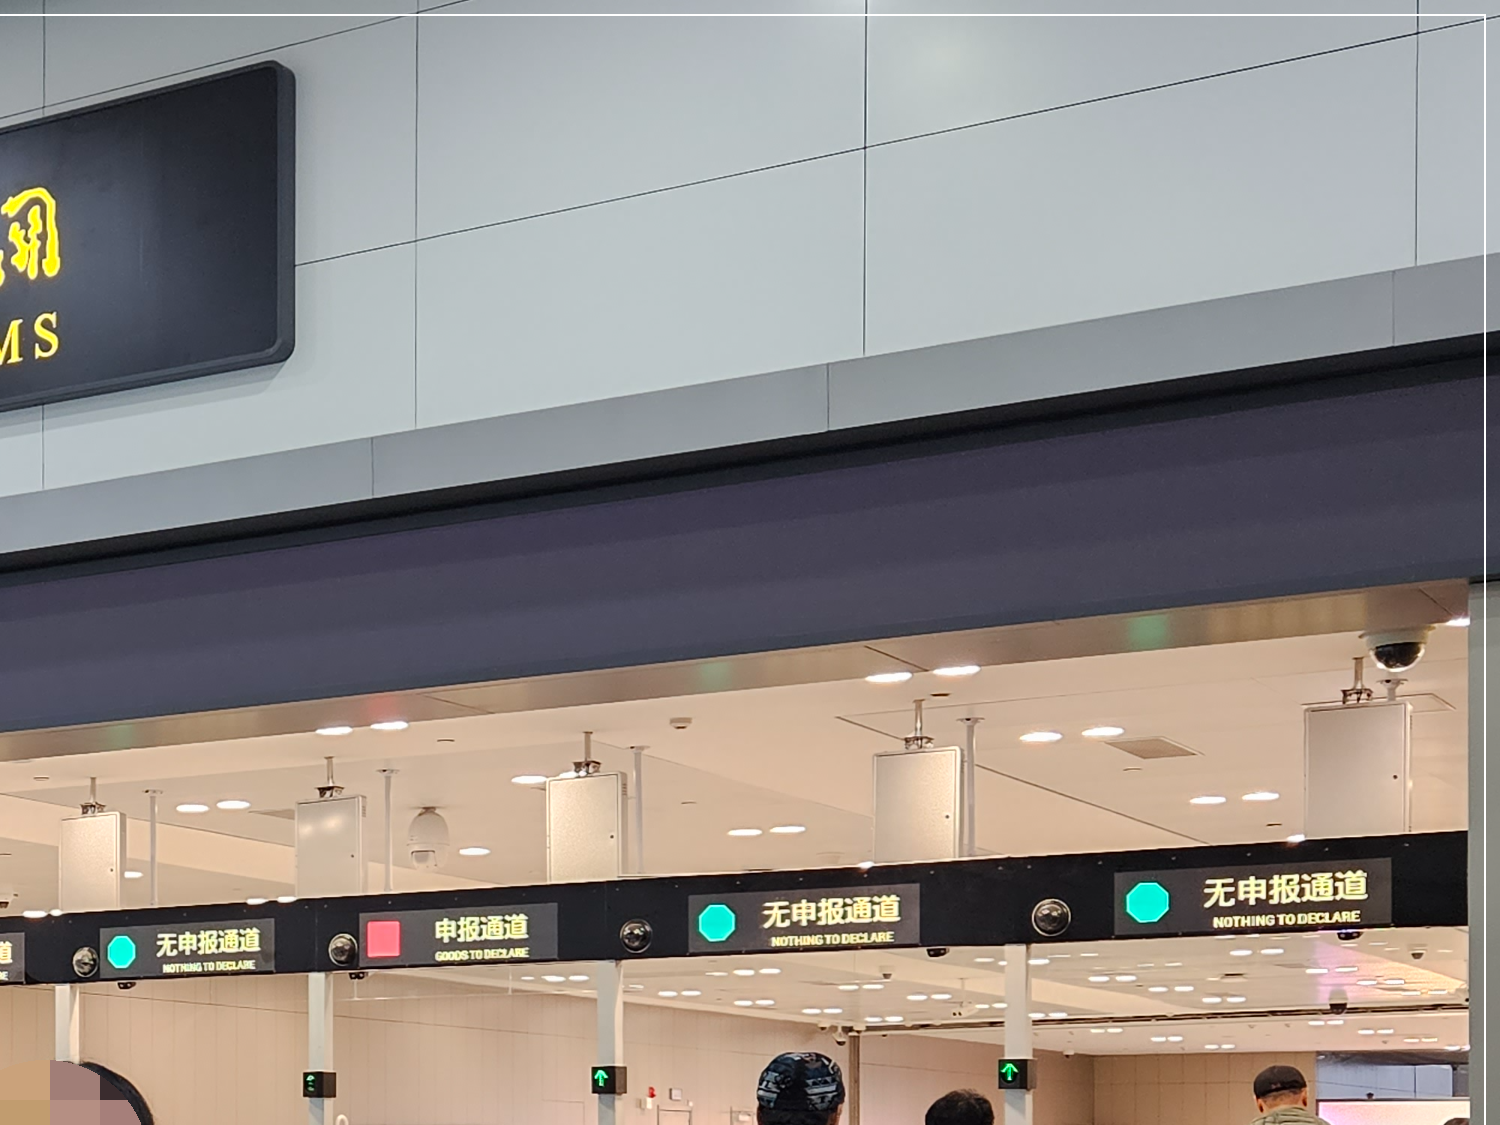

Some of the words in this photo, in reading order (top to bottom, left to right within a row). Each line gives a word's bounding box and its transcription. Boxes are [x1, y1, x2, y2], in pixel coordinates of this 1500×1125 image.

[1203, 869, 1368, 908] 无申报通道
[761, 894, 902, 929] 无申报通道
[1212, 914, 1275, 929] NOTHING
[1277, 913, 1296, 926] TO
[1297, 910, 1361, 925] DECLARE
[435, 913, 529, 943] 申报通道
[771, 934, 823, 947] NOTHING
[824, 933, 841, 945] TO
[841, 931, 895, 944] DECLARE
[156, 927, 261, 957] 无申报通道
[162, 962, 202, 974] NOTHING
[202, 961, 215, 972] TO
[215, 959, 256, 971] DECLARE
[434, 949, 469, 962] GOODS
[469, 949, 483, 960] TO
[483, 947, 530, 959] DECLARE
